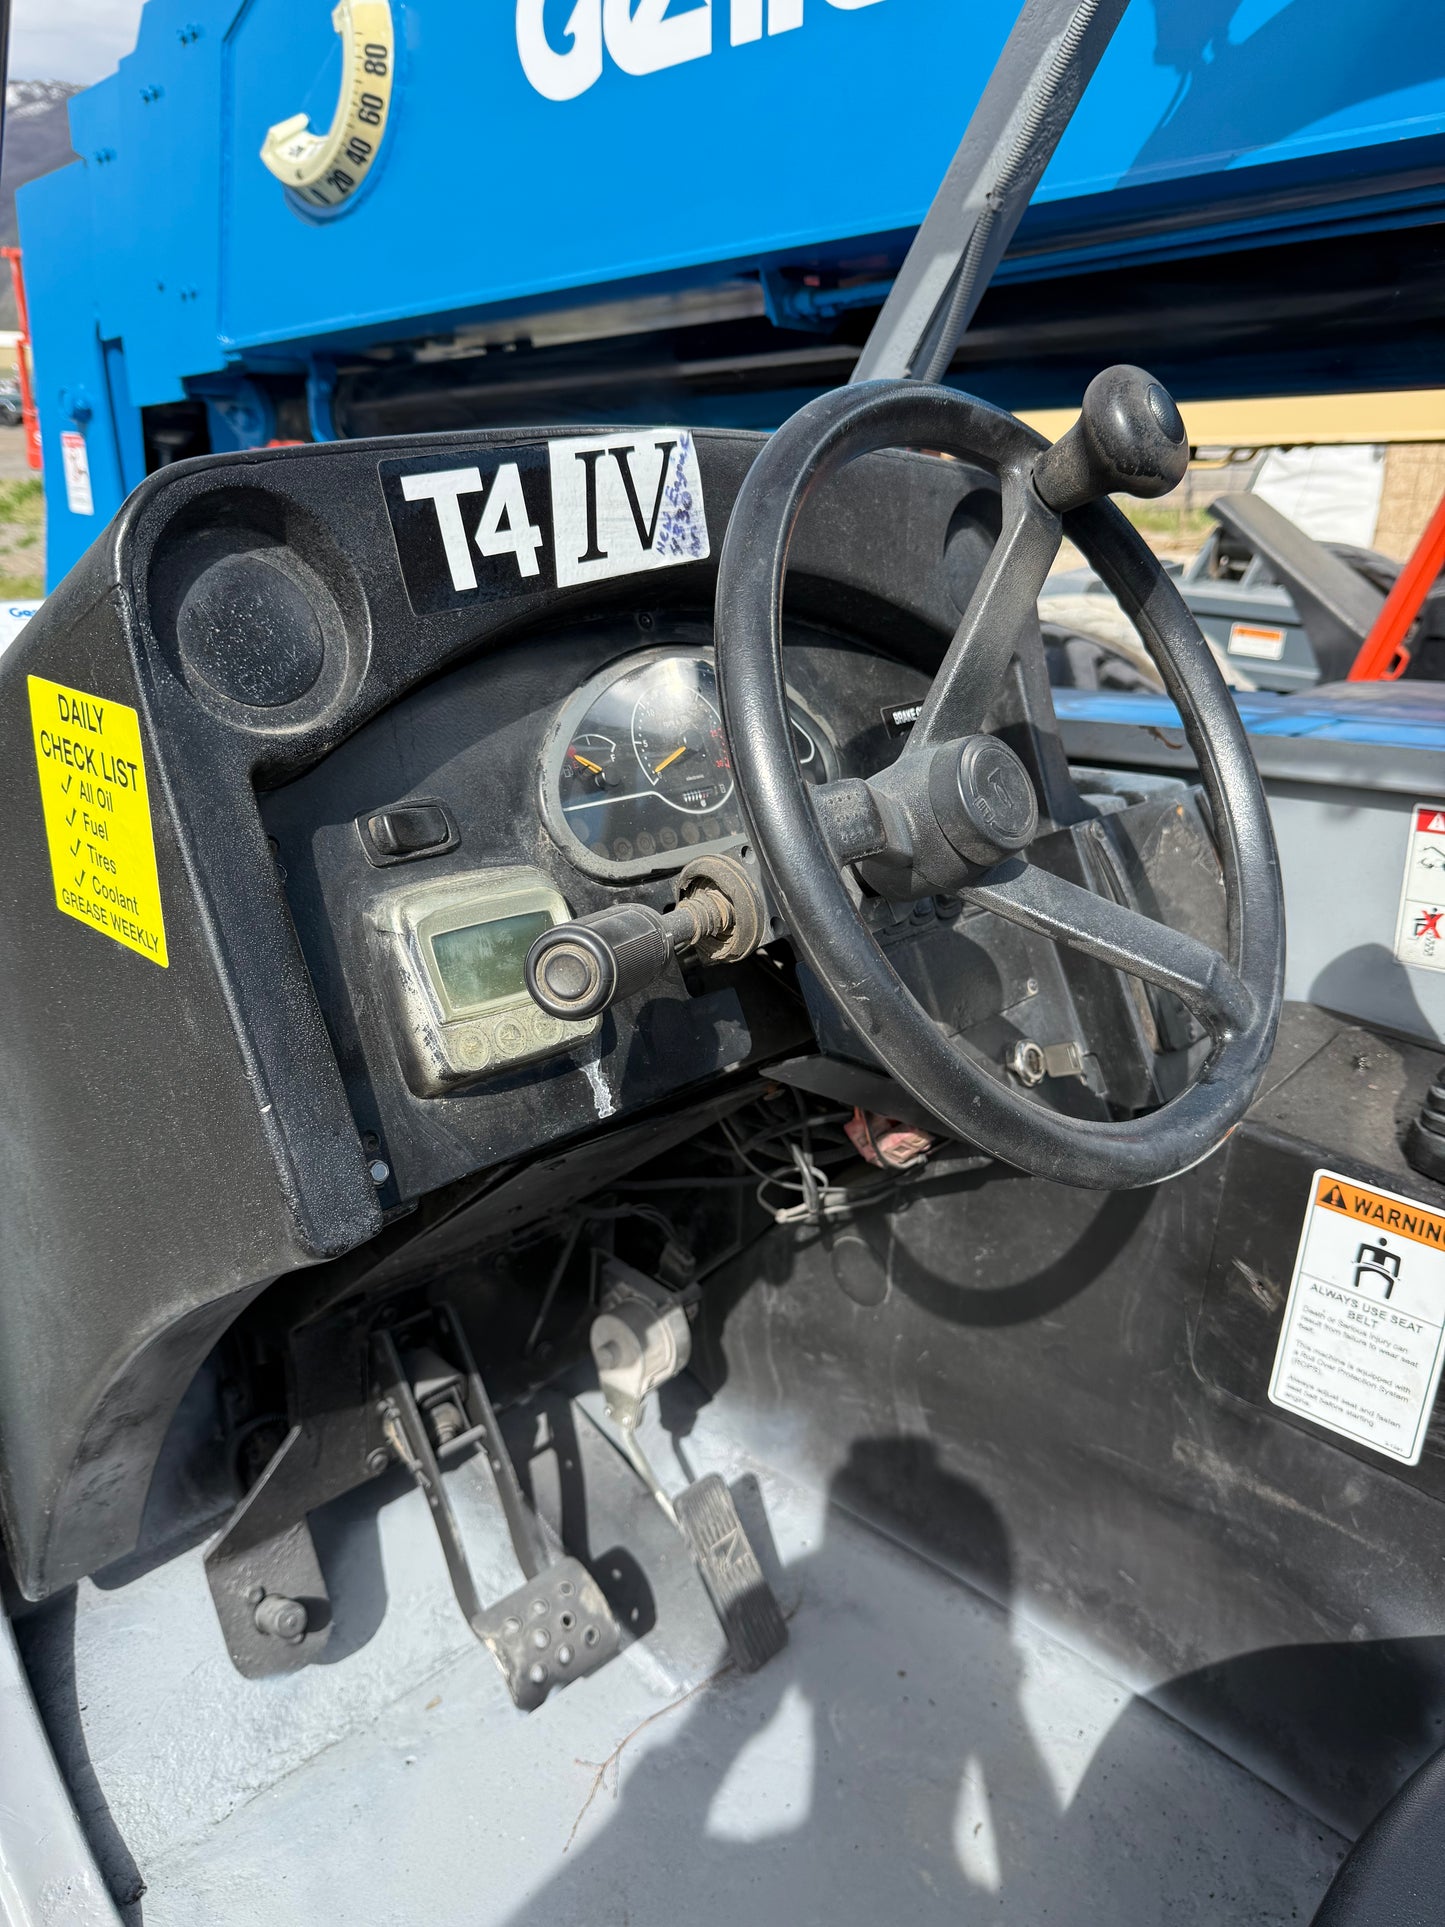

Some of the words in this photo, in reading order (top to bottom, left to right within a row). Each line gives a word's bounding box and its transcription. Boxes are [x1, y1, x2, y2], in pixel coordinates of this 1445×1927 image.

[364, 43, 388, 77] 80
[358, 93, 384, 126] 60
[346, 137, 372, 166] 40
[327, 169, 354, 194] 20
[400, 463, 543, 592] T4
[574, 440, 678, 564] IV
[57, 693, 104, 735] DAILY
[892, 707, 917, 725] BRAKE
[610, 753, 616, 762] F
[643, 740, 649, 748] 5
[40, 729, 98, 777] CHECK
[101, 751, 138, 792] LIST
[80, 780, 94, 805] All
[96, 787, 114, 812] Oil
[83, 812, 109, 841] Fuel
[86, 843, 117, 875] Tires
[92, 875, 139, 915] Coolant
[61, 888, 109, 926] GREASE
[109, 911, 159, 953] WEEKLY
[1354, 1195, 1445, 1243] WARNIN
[1310, 1283, 1358, 1308] ALWAYS
[1362, 1303, 1387, 1320] USE
[1390, 1314, 1423, 1333] SEAT
[1347, 1310, 1378, 1328] BELT
